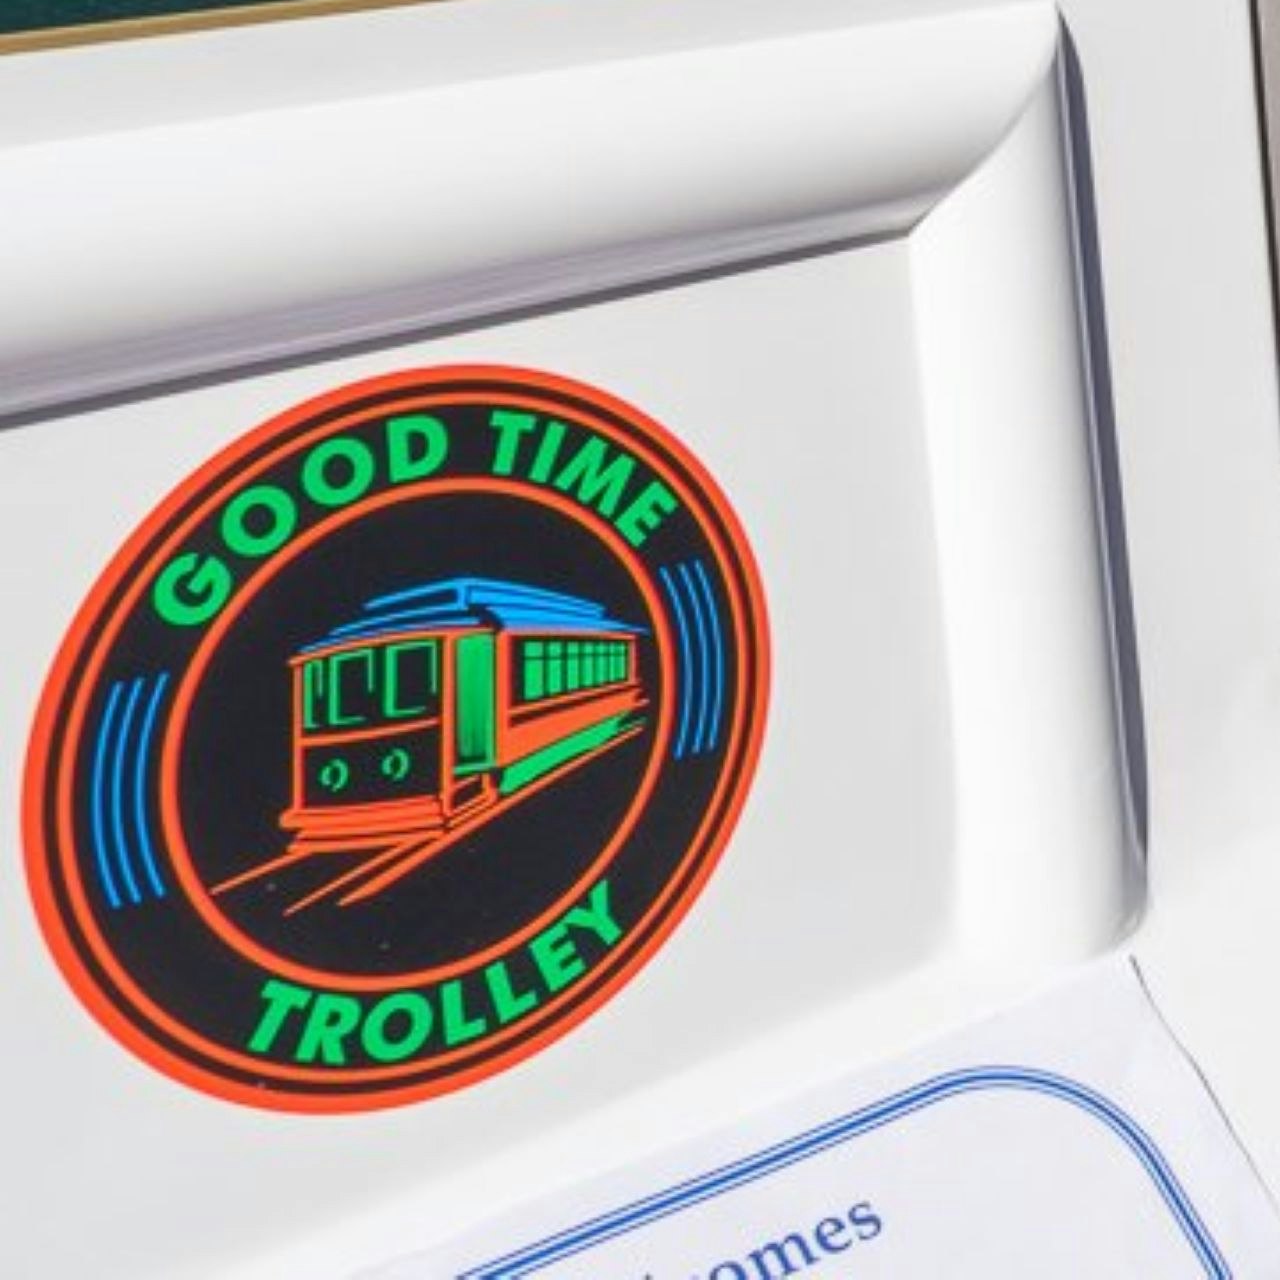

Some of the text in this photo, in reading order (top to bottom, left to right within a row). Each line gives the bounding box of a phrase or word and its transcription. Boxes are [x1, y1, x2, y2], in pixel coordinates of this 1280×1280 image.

[154, 410, 677, 626] GOOD TIME
[248, 880, 622, 1064] TROLLEY
[645, 1200, 882, 1280] omes
